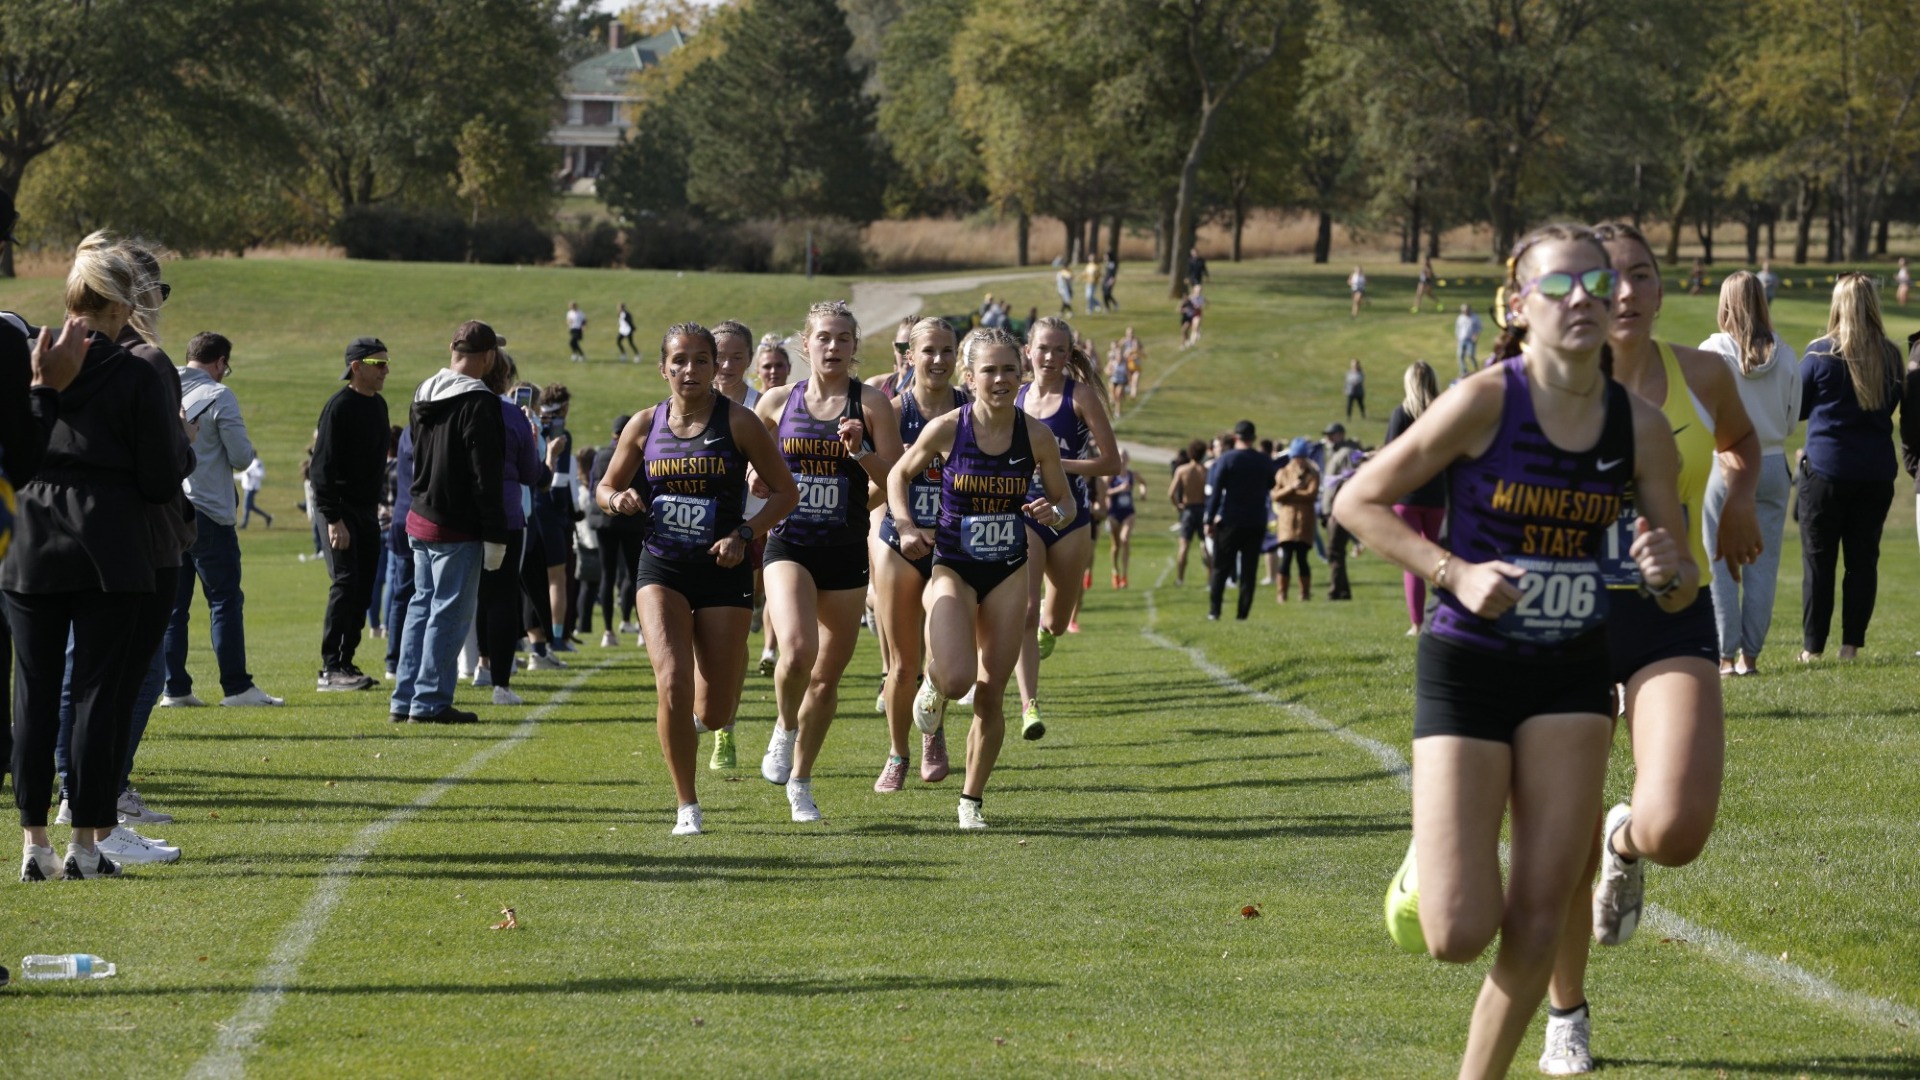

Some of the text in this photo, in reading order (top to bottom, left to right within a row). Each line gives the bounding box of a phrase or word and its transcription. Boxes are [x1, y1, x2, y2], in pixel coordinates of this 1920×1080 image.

[783, 438, 849, 458] MINNESO
[649, 457, 726, 477] MINNESOTA
[800, 460, 837, 476] STATE
[667, 480, 707, 494] STATE
[953, 473, 1027, 494] MINNESOTA
[797, 482, 839, 509] 200
[972, 497, 1010, 513] STATE
[662, 501, 706, 530] 202
[970, 521, 1016, 546] 204
[1522, 525, 1588, 557] STATE
[1515, 572, 1597, 618] 206
